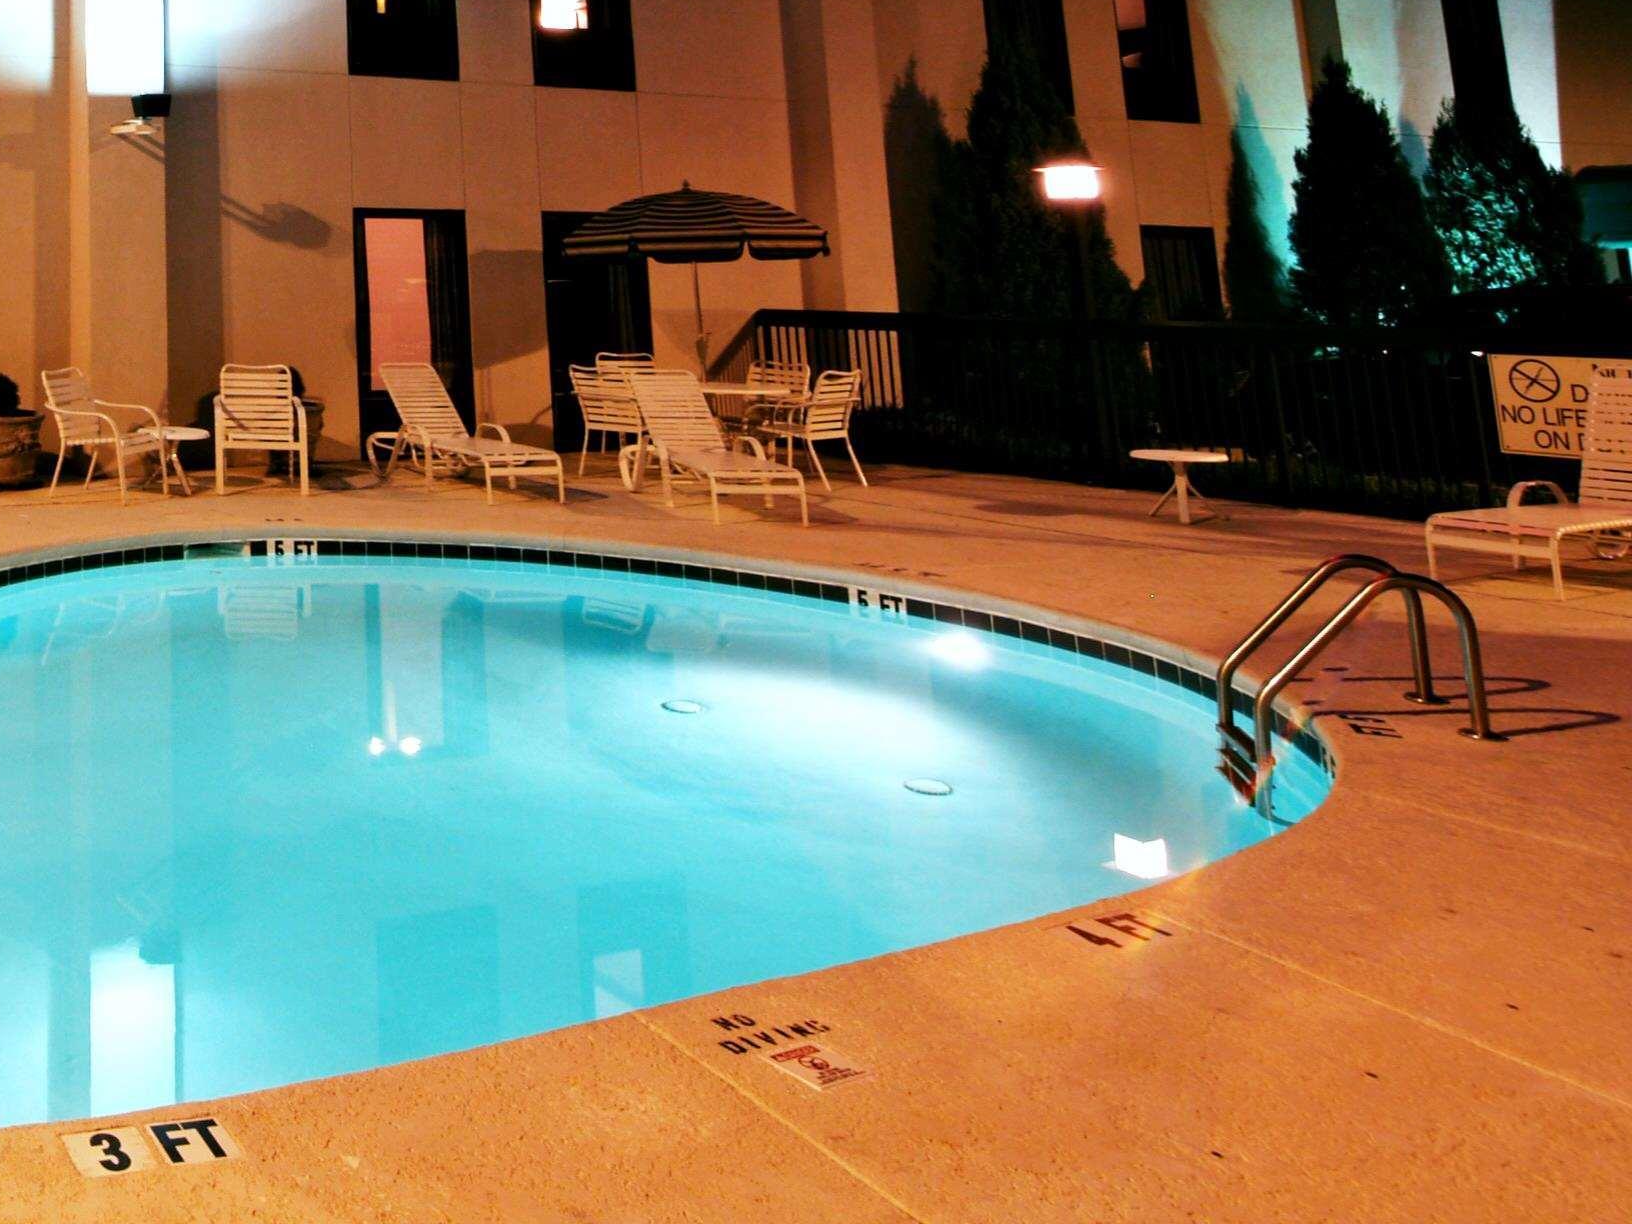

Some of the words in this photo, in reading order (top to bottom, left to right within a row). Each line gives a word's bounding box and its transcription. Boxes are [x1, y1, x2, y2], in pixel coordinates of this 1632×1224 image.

[1500, 404, 1536, 424] NO
[1534, 429, 1571, 451] ON
[294, 540, 314, 556] FT
[879, 593, 904, 613] FT
[1066, 925, 1123, 949] 4
[1095, 913, 1174, 942] FT
[710, 1014, 756, 1031] NO
[718, 1020, 831, 1055] DIVING
[89, 1133, 132, 1172] 3
[150, 1118, 228, 1164] FT
